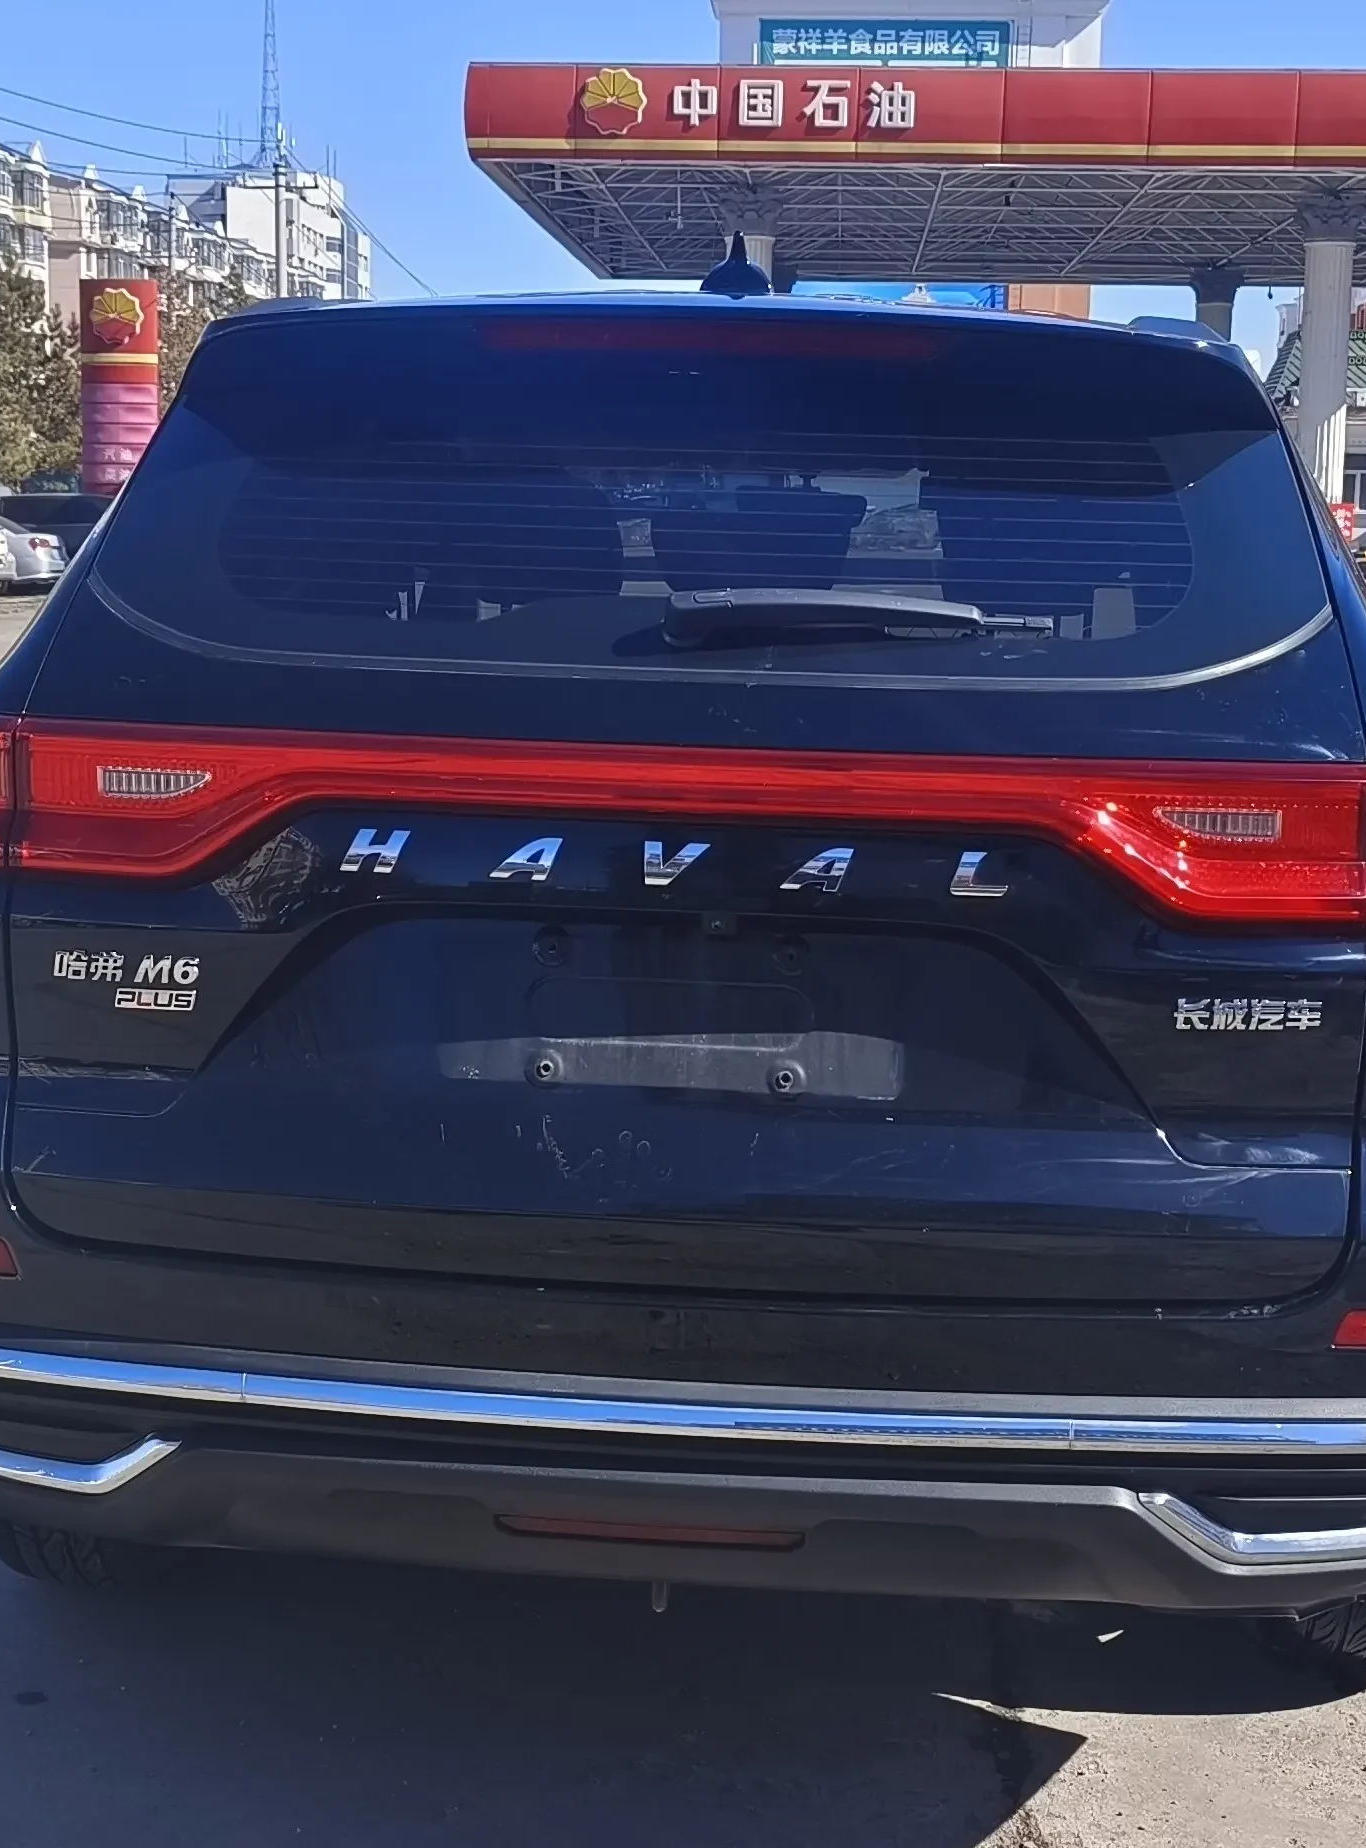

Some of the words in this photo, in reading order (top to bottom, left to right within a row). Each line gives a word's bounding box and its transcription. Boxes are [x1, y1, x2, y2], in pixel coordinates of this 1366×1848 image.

[772, 28, 1000, 56] 蒙祥羊食品有限公司
[672, 78, 916, 129] 中国石油
[339, 828, 1010, 898] HAVAL
[53, 950, 125, 982] 哈弗
[134, 954, 200, 985] M6
[116, 989, 195, 1010] PLUS
[1173, 998, 1323, 1031] 长城汽车
